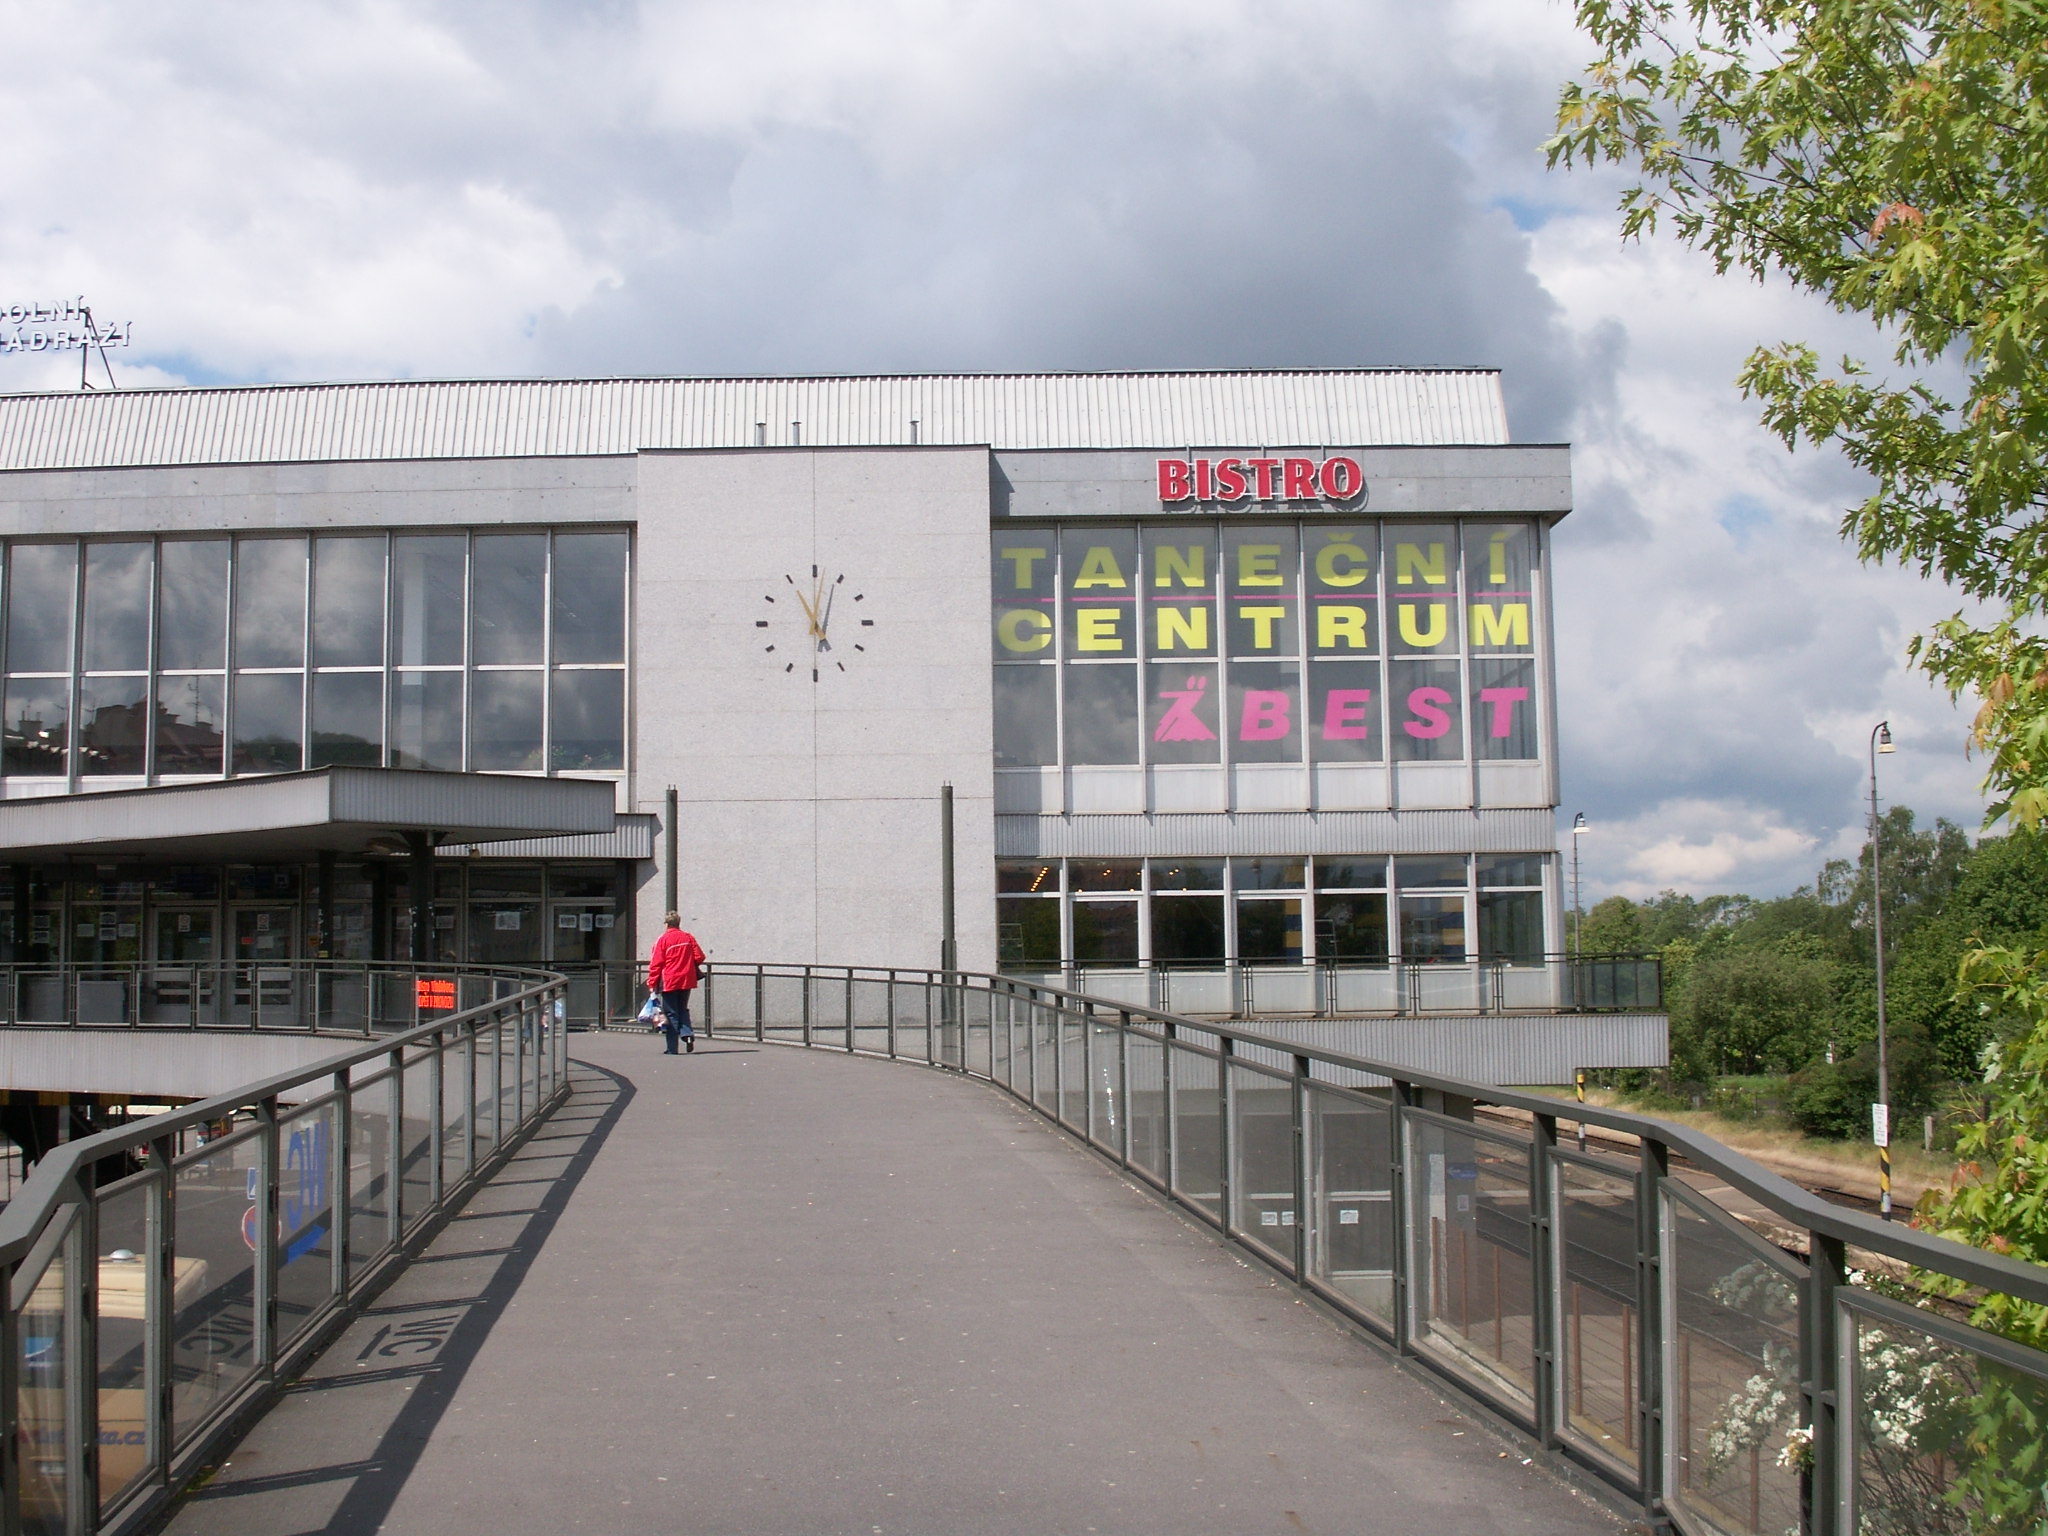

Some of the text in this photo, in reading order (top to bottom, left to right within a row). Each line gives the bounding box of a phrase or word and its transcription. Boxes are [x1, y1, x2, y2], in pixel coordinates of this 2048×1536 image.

[0, 295, 84, 324] OLNÍ
[0, 321, 132, 352] ÁDRAŽÍ
[1156, 456, 1364, 502] BISTRO
[1000, 532, 1509, 590] TANEČNÍ
[997, 603, 1529, 653] CENTRUM
